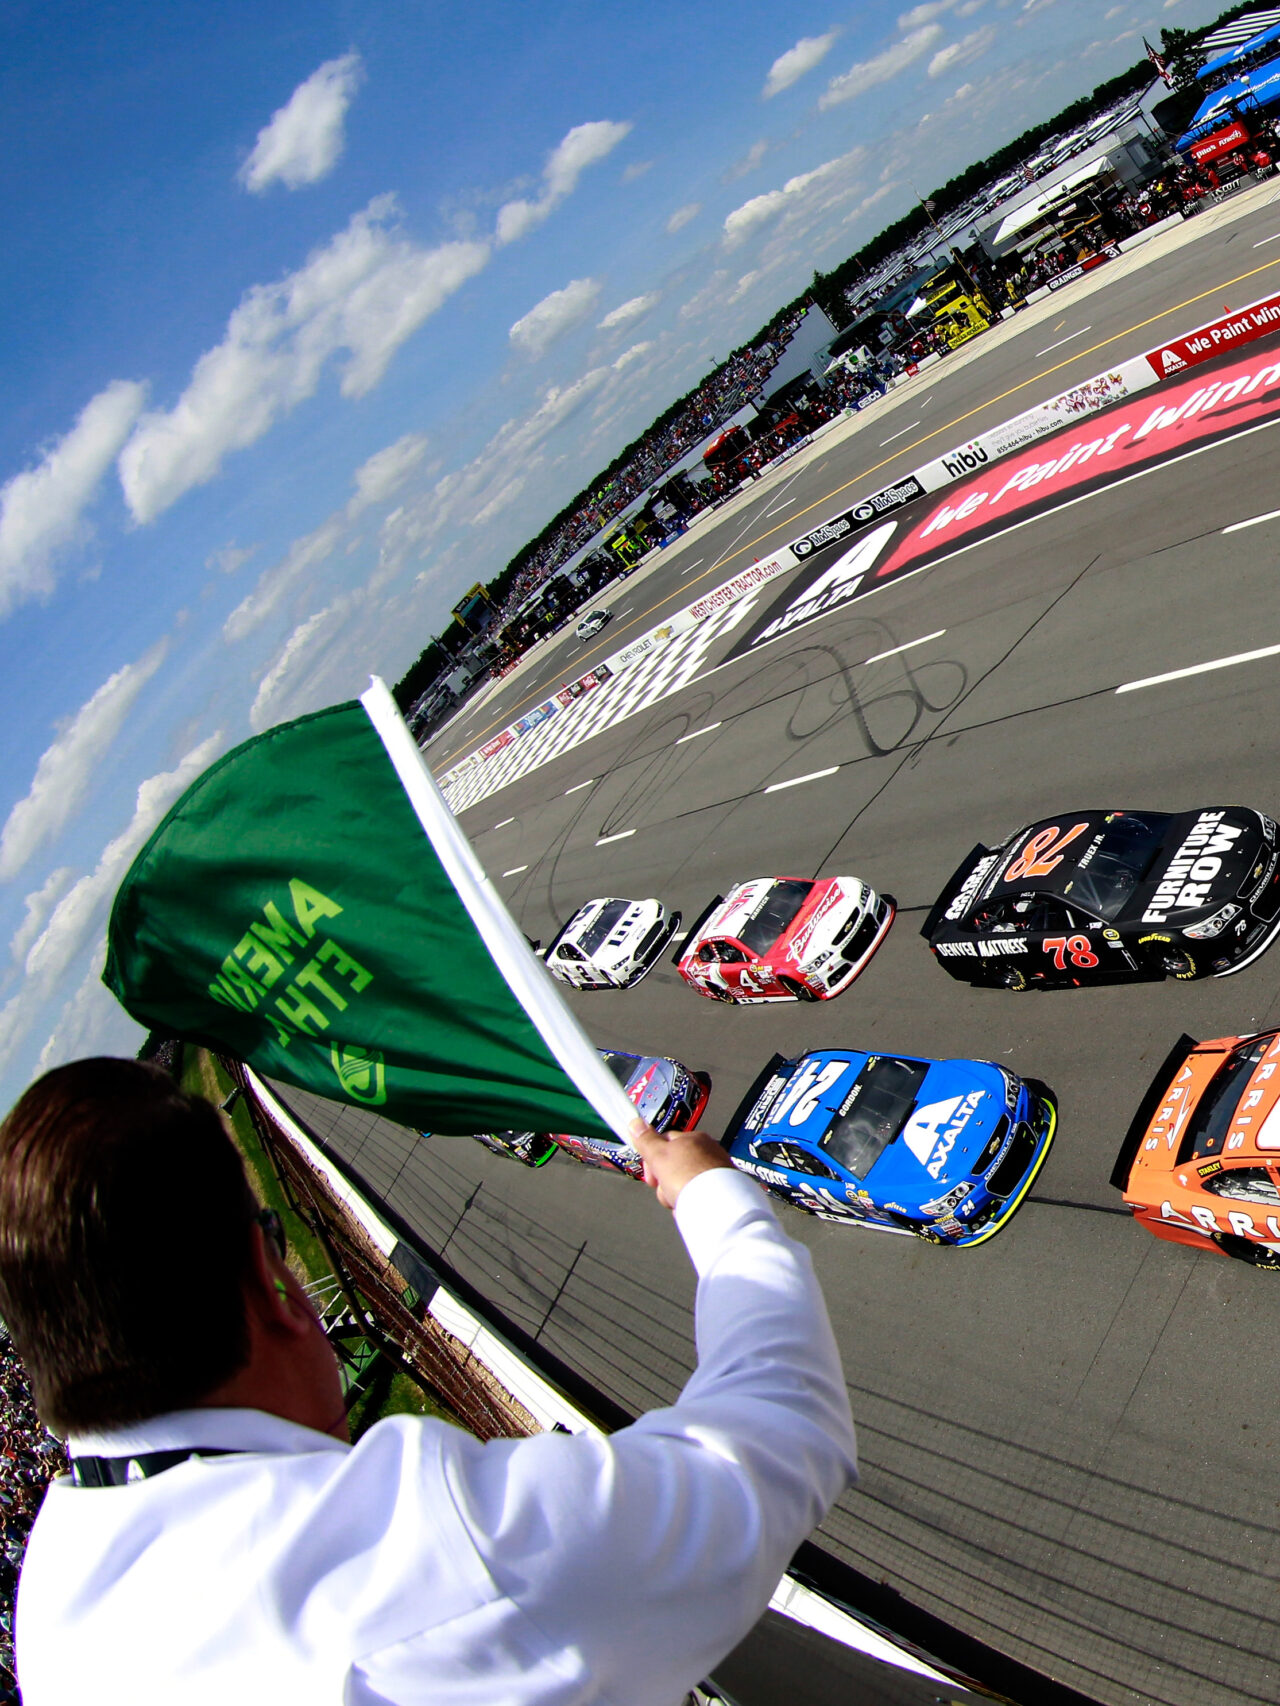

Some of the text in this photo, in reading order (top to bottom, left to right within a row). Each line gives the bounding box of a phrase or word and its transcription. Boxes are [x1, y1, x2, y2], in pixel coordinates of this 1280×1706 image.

[1050, 266, 1084, 290] GRAINGER
[1185, 336, 1210, 355] We
[1211, 318, 1252, 344] Paint
[1164, 361, 1188, 374] AXALTA
[858, 390, 882, 408] GEICO
[1036, 419, 1064, 435] hibu.com
[919, 492, 990, 538] We
[989, 424, 1132, 505] Paint
[810, 480, 919, 546] ModSpace ModSpace
[688, 561, 782, 620] WESTCHESTER TRACTOR.com
[751, 575, 865, 646] AXALTA
[619, 639, 652, 663] CHEVROLET
[1004, 822, 1090, 883] 78
[1078, 834, 1106, 869] TRUEX JR.
[1141, 811, 1226, 923] FURNITURE
[1174, 823, 1243, 908] ROW
[1249, 859, 1275, 903] CHEVROLET
[750, 896, 770, 921] HARVICK
[786, 883, 842, 962] Budweiser
[1138, 932, 1172, 945] GOODYEAR
[1234, 919, 1247, 937] 78
[936, 938, 1028, 957] DENVER MATTRESS
[1042, 933, 1100, 970] 78
[576, 965, 595, 982] 2
[740, 970, 764, 993] 4
[771, 1059, 850, 1127] 24
[1145, 1066, 1193, 1151] ARRIS
[926, 1089, 987, 1180] AXALTA
[756, 1164, 792, 1188] STATE
[984, 1135, 1014, 1181] CHEVROLET
[1198, 1161, 1221, 1177] STANLEY
[960, 1200, 976, 1216] 24
